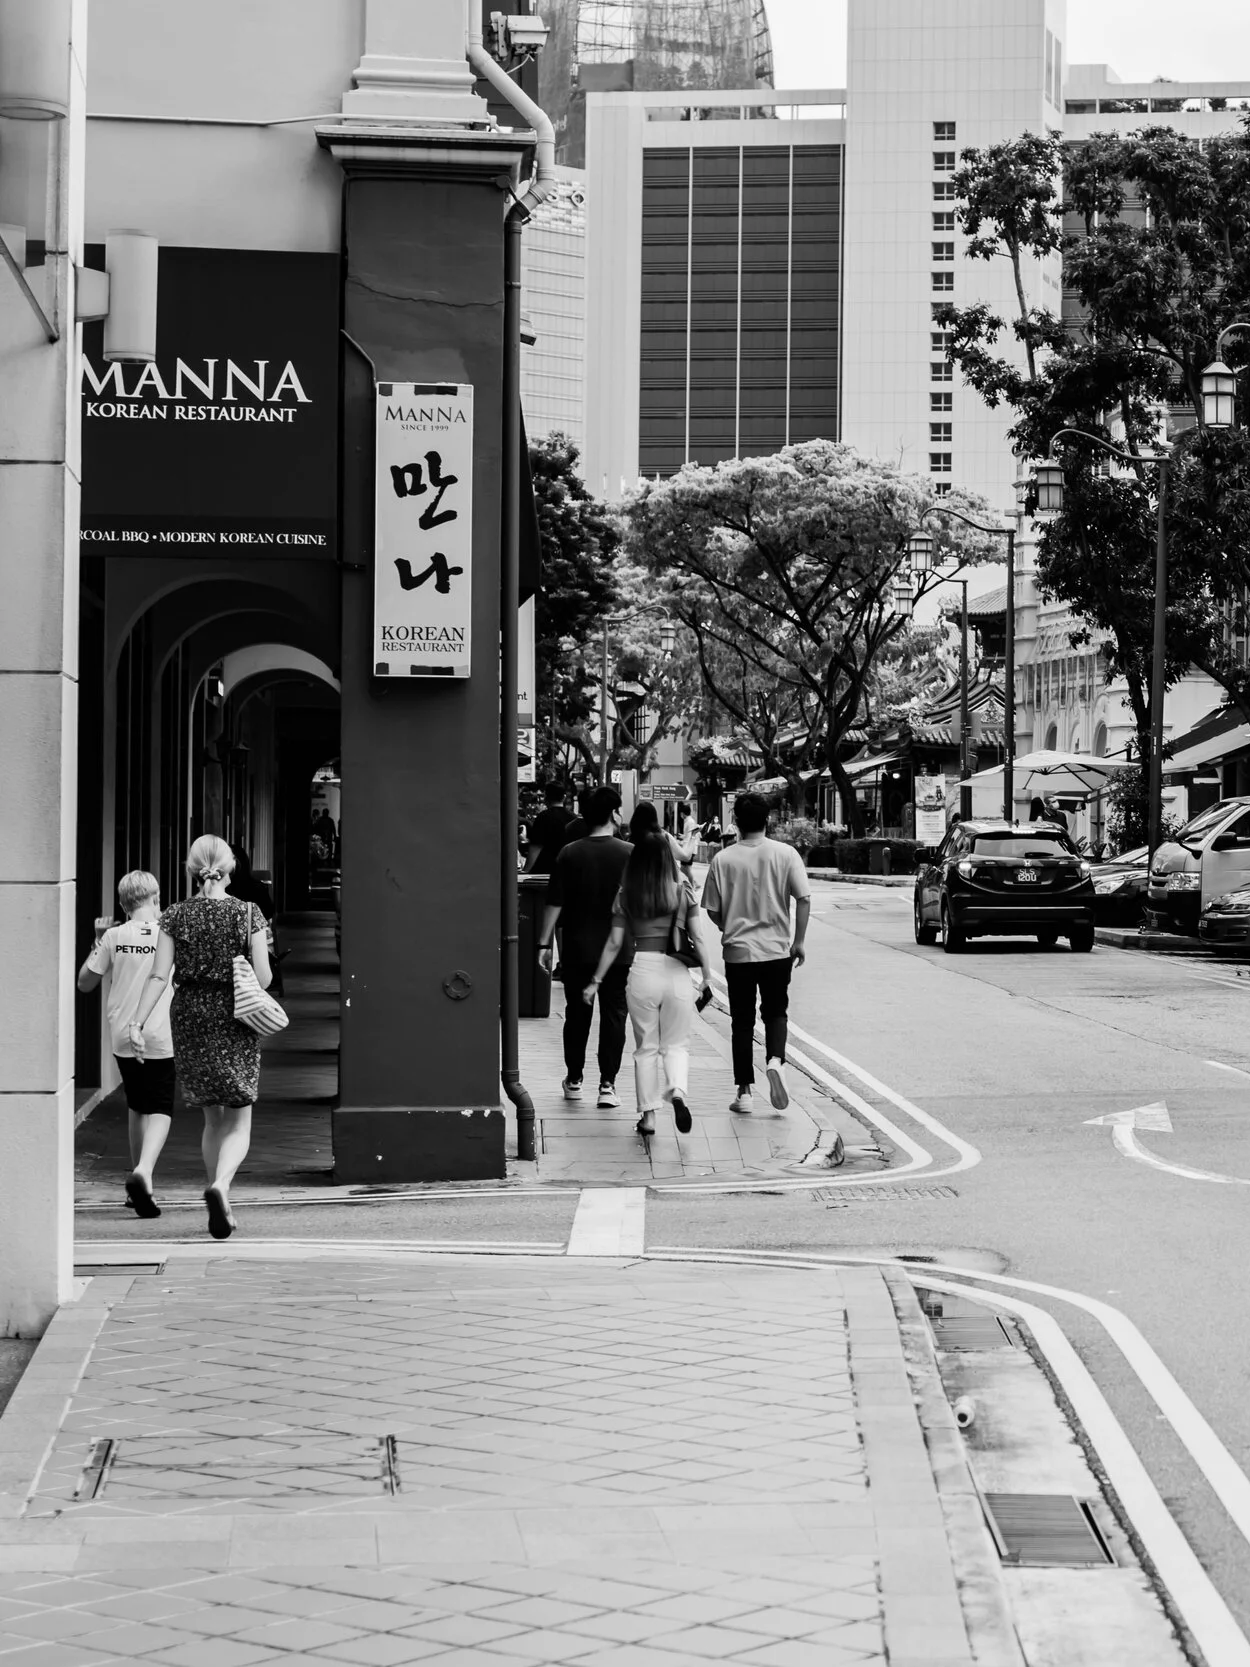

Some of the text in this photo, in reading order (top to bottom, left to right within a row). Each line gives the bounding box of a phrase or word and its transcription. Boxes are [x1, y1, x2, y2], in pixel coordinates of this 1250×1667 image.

[81, 353, 312, 402] MANNA
[86, 402, 297, 423] KOREAN RESTAURANT
[385, 405, 467, 423] MANNA
[122, 531, 149, 543] BBQ
[159, 532, 216, 543] MODERN
[219, 532, 275, 544] KOREAN
[276, 533, 327, 546] CUISINE
[381, 626, 465, 641] KOREAN
[382, 642, 464, 653] RESTAURANT
[115, 945, 157, 955] PETRON
